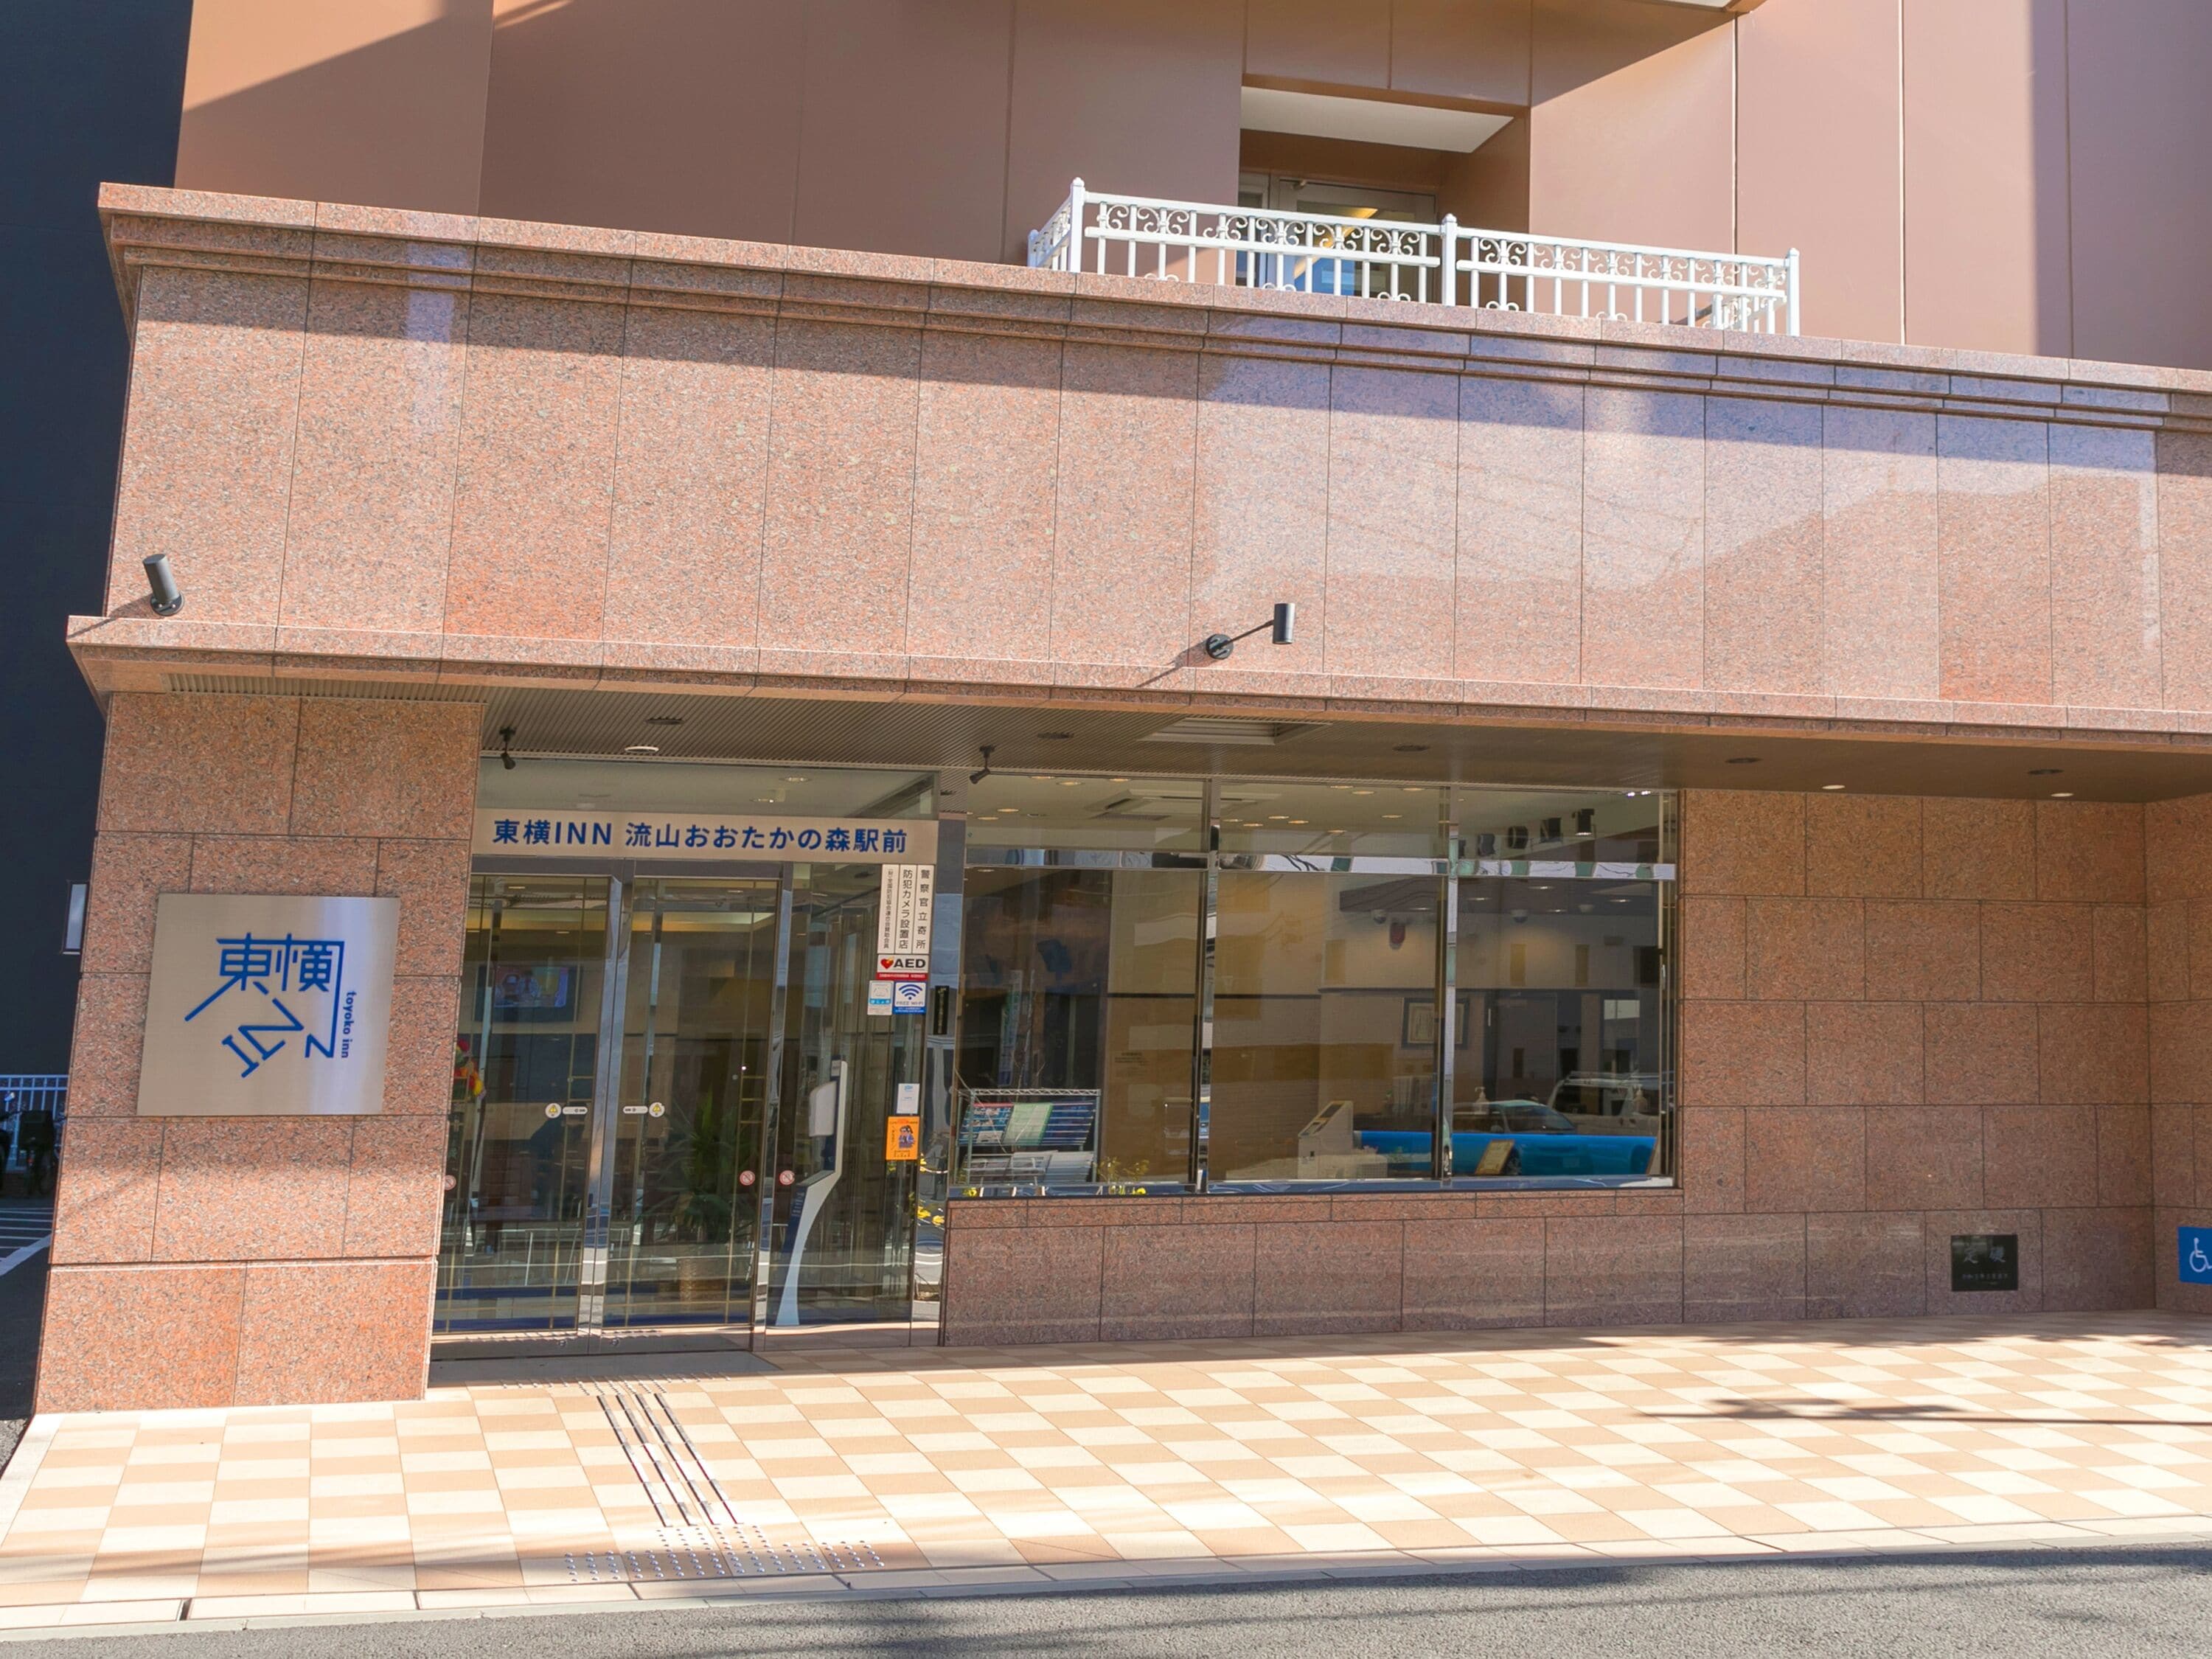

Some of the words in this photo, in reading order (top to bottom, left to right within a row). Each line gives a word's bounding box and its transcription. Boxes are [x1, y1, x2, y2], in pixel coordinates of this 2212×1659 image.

[493, 819, 612, 846] 東横INN
[625, 822, 907, 854] 流山おおたかの森駅前
[898, 869, 913, 949] 防犯カメラ設置店
[916, 869, 931, 949] 警察官立寄所
[894, 959, 926, 968] AED
[342, 991, 357, 1035] toyoko
[341, 1039, 352, 1059] inn
